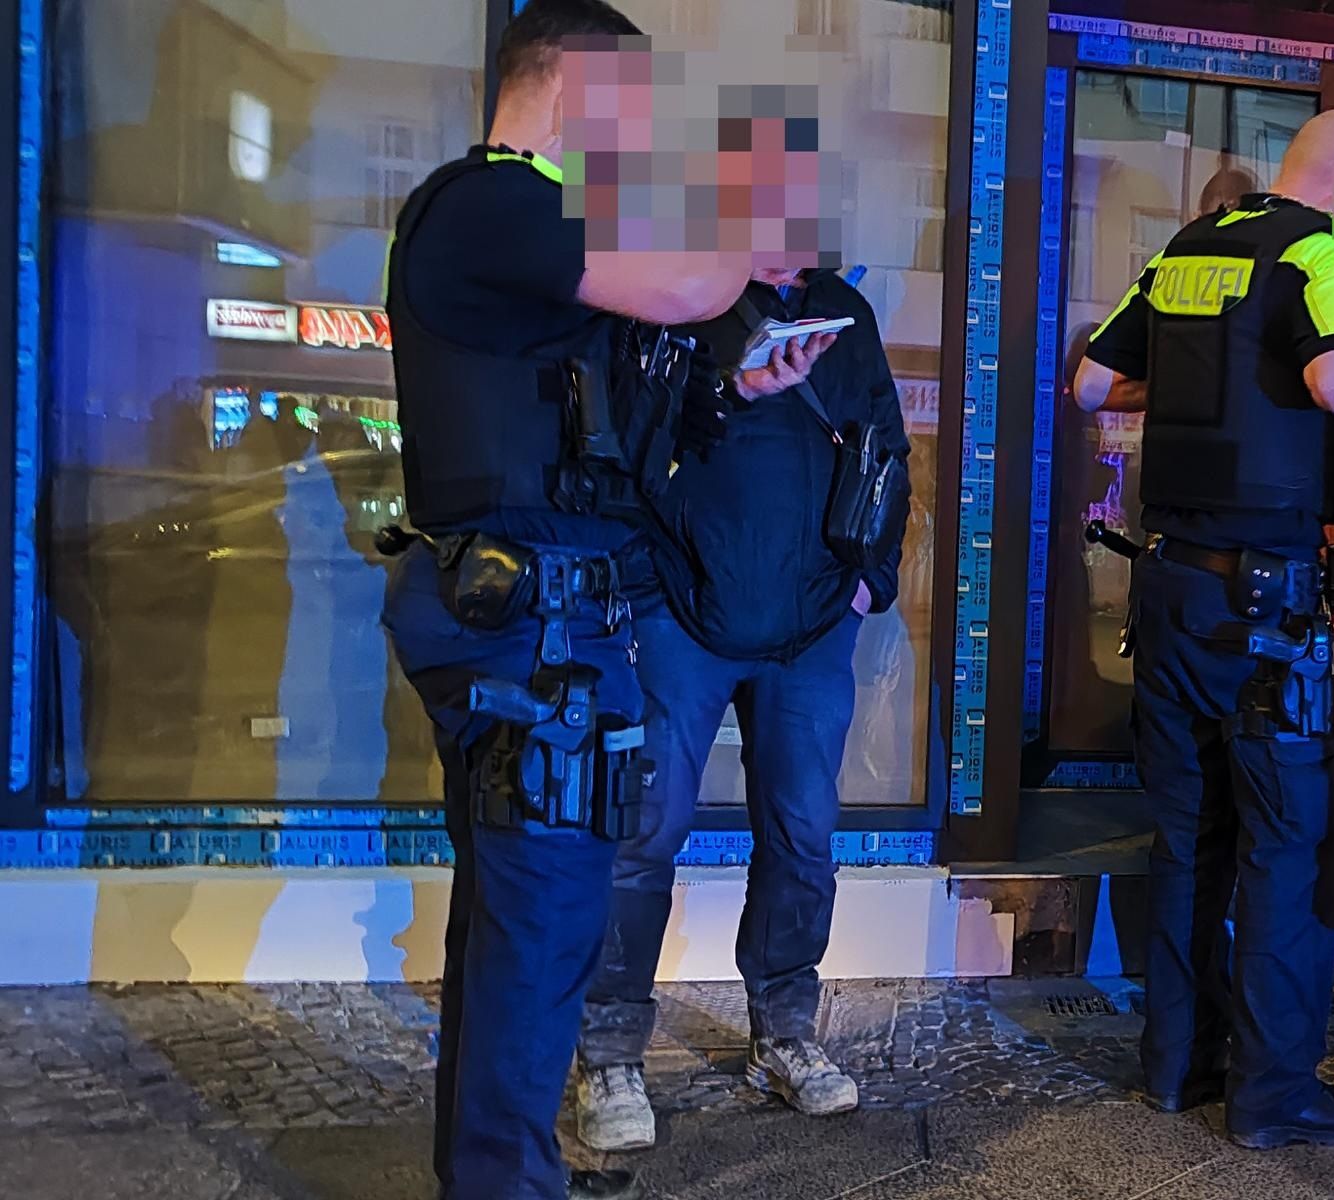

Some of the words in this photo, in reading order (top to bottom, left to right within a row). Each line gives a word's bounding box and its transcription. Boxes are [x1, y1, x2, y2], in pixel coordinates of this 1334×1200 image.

[993, 11, 1007, 67] ALURIS
[989, 100, 1004, 158] ALURIS
[986, 191, 1000, 248] ALURIS
[983, 281, 997, 339] ALURIS
[1151, 264, 1245, 306] POLIZEI
[980, 370, 994, 429] ALURIS
[977, 461, 991, 516] ALURIS
[974, 550, 988, 605] ALURIS
[971, 638, 985, 694] ALURIS
[967, 727, 981, 783] ALURIS
[63, 835, 130, 849] ALURIS
[174, 834, 241, 849] ALURIS
[284, 834, 350, 849] ALURIS
[691, 836, 752, 849] ALURIS
